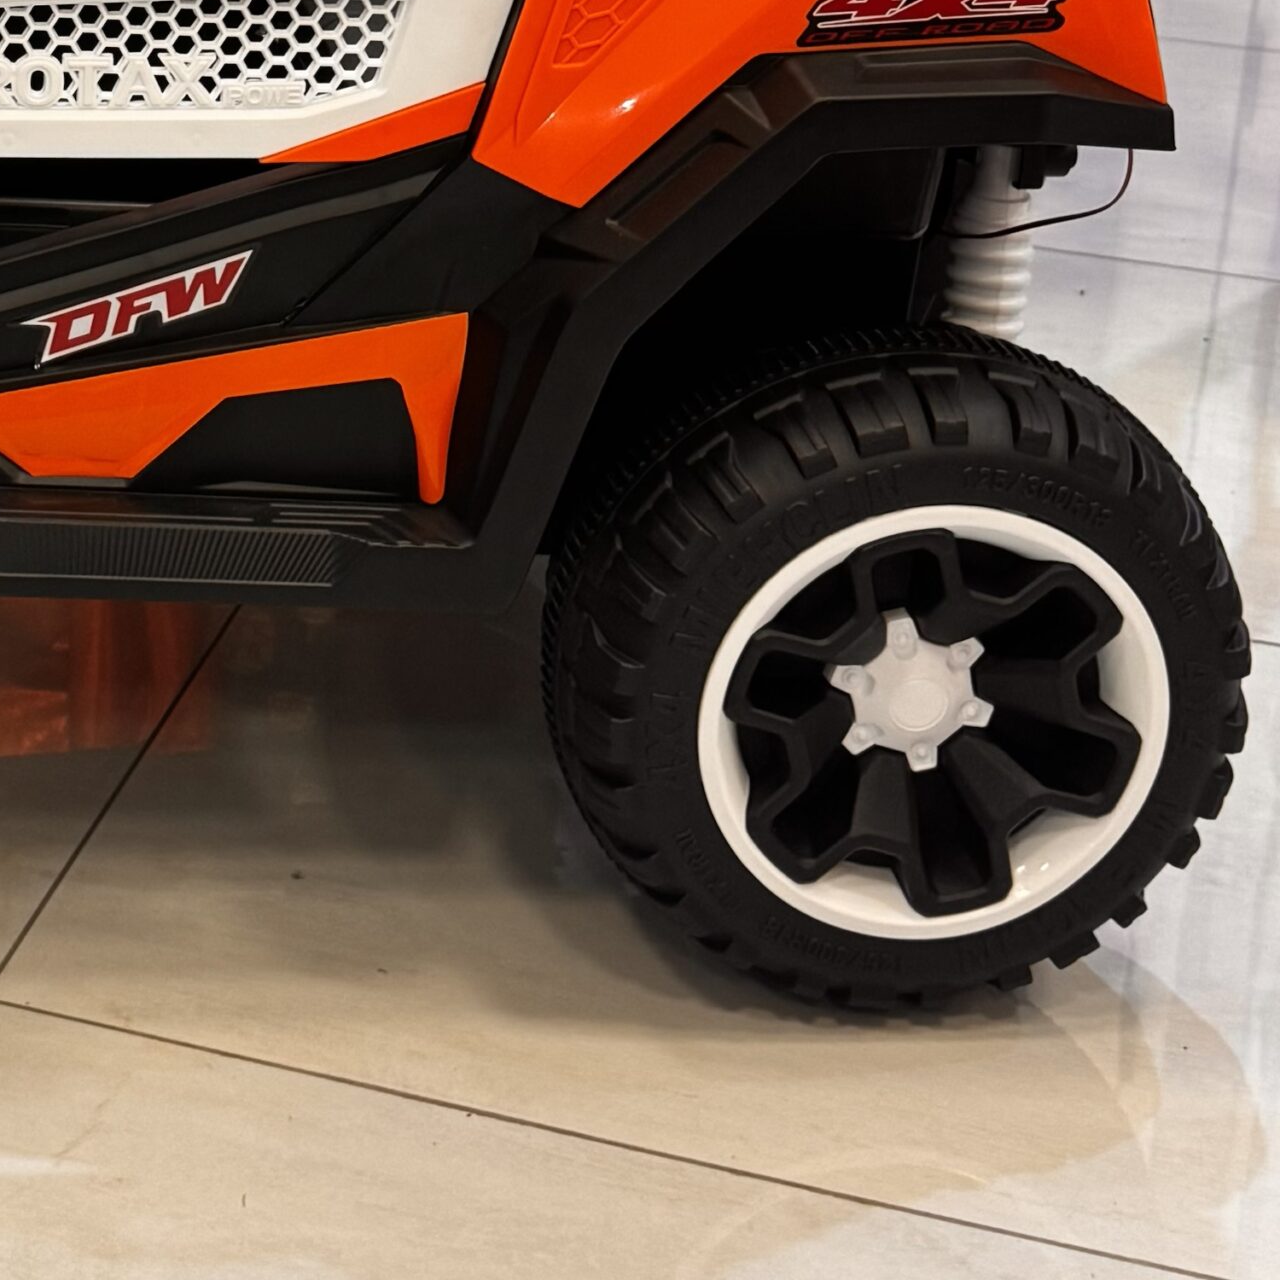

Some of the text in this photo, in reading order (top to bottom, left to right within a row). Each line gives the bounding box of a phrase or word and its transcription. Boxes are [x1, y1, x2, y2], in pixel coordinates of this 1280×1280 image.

[804, 17, 1057, 45] OFF ROAD
[22, 251, 252, 362] DFW
